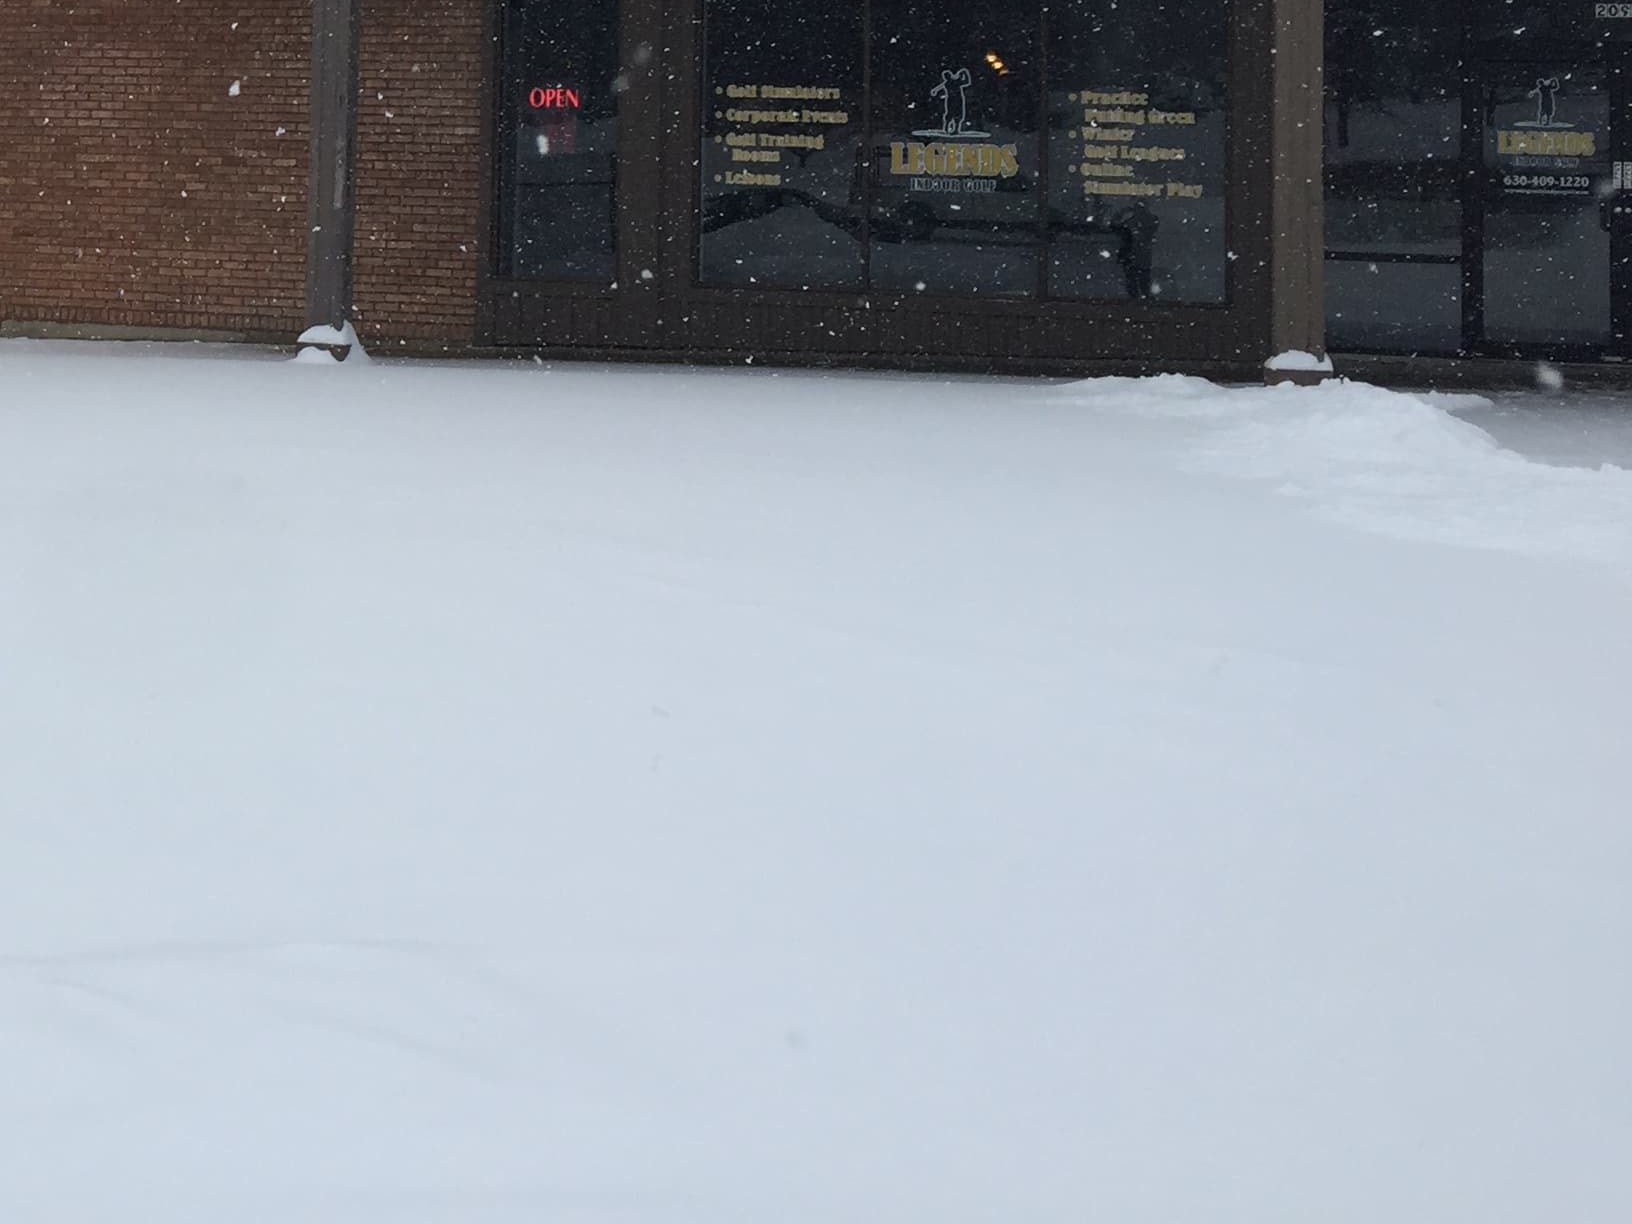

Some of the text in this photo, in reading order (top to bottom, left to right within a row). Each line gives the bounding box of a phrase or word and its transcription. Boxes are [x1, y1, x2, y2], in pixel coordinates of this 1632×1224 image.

[529, 88, 580, 109] OPEN
[1080, 90, 1149, 105] Practice
[726, 108, 849, 124] Corporate Events
[1147, 109, 1196, 124] Green
[759, 132, 825, 150] Training
[889, 141, 1020, 178] LEGENDS
[909, 177, 997, 193] INDOOR GOLF
[1503, 174, 1590, 188] 630-409-1220
[1166, 182, 1203, 199] Play
